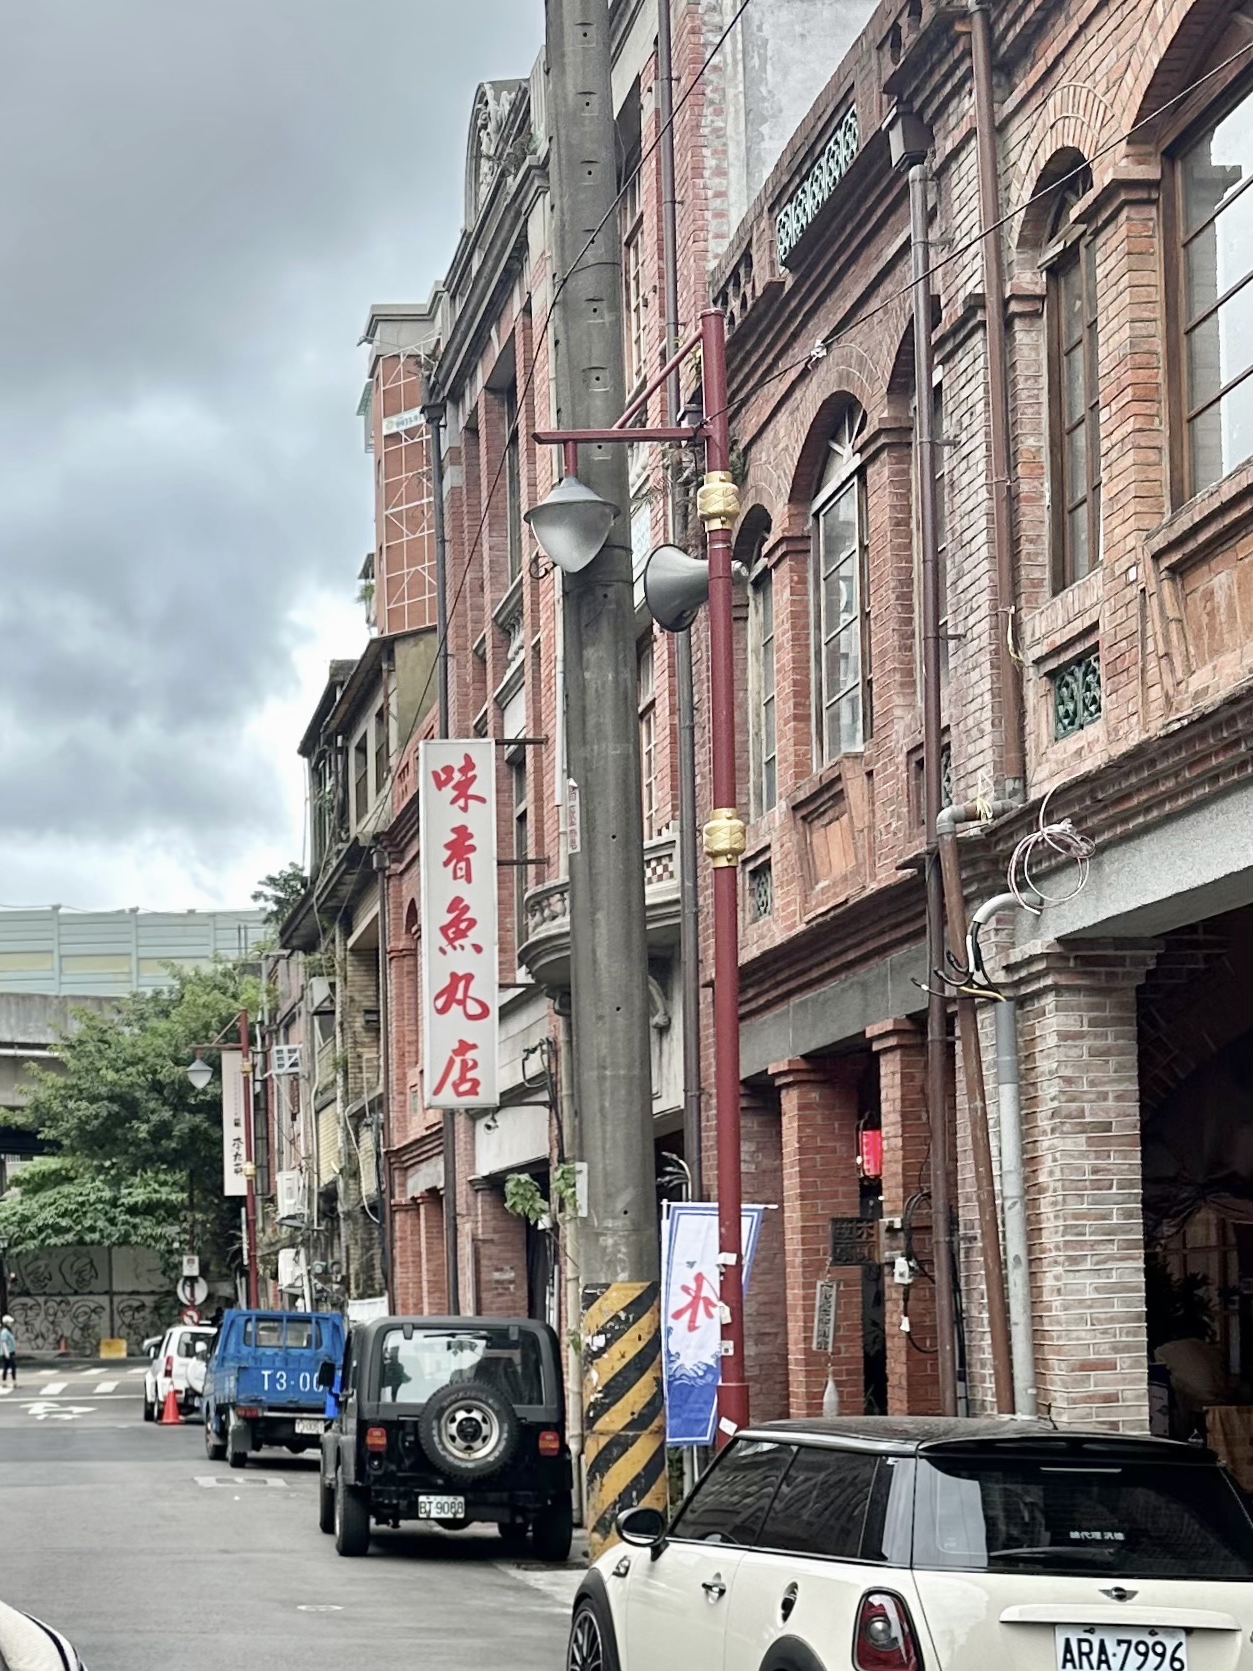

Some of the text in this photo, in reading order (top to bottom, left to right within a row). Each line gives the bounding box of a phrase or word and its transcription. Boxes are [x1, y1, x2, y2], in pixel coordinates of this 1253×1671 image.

[431, 753, 490, 1098] 味香魚丸店
